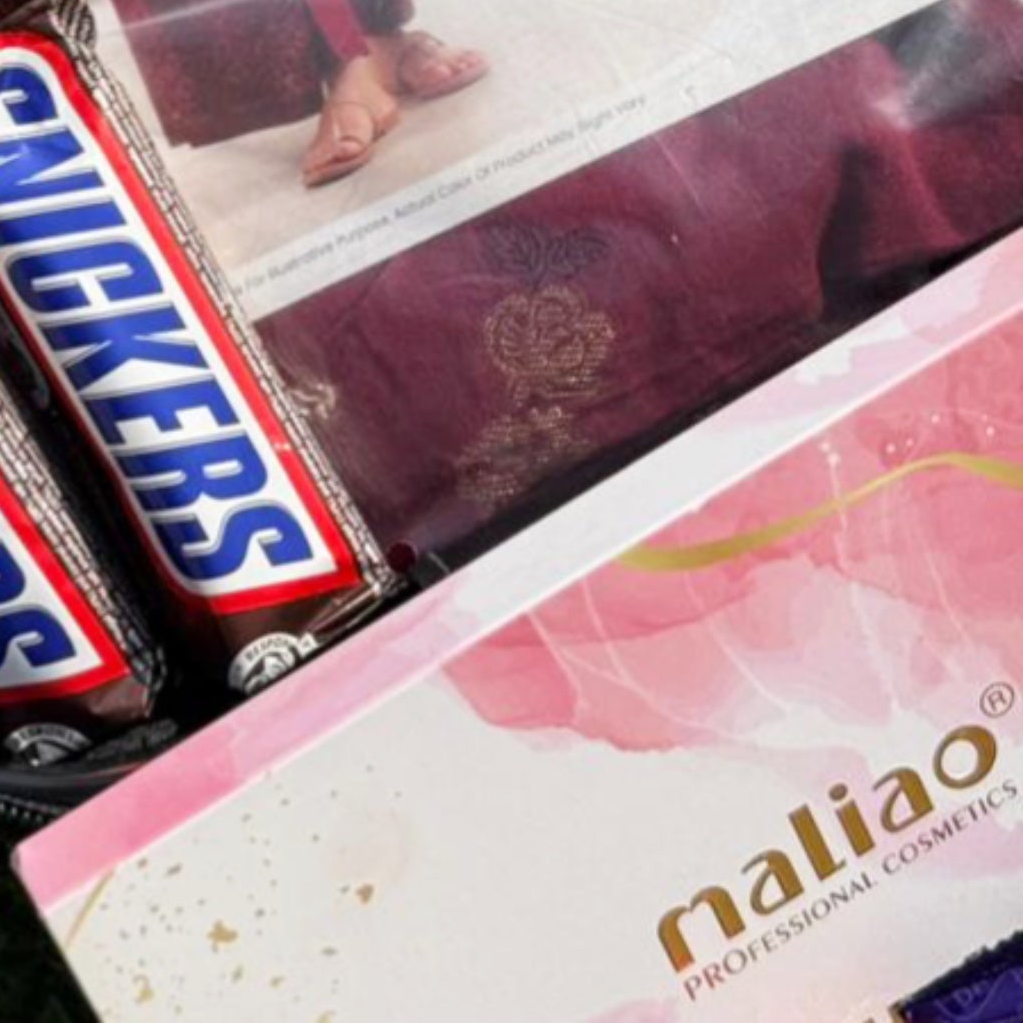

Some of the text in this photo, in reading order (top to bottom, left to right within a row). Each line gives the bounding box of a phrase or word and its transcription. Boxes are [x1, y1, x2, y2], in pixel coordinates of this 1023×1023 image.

[657, 724, 997, 974] maliao
[683, 778, 1019, 1002] PROFESSIONAL COSMETICS
